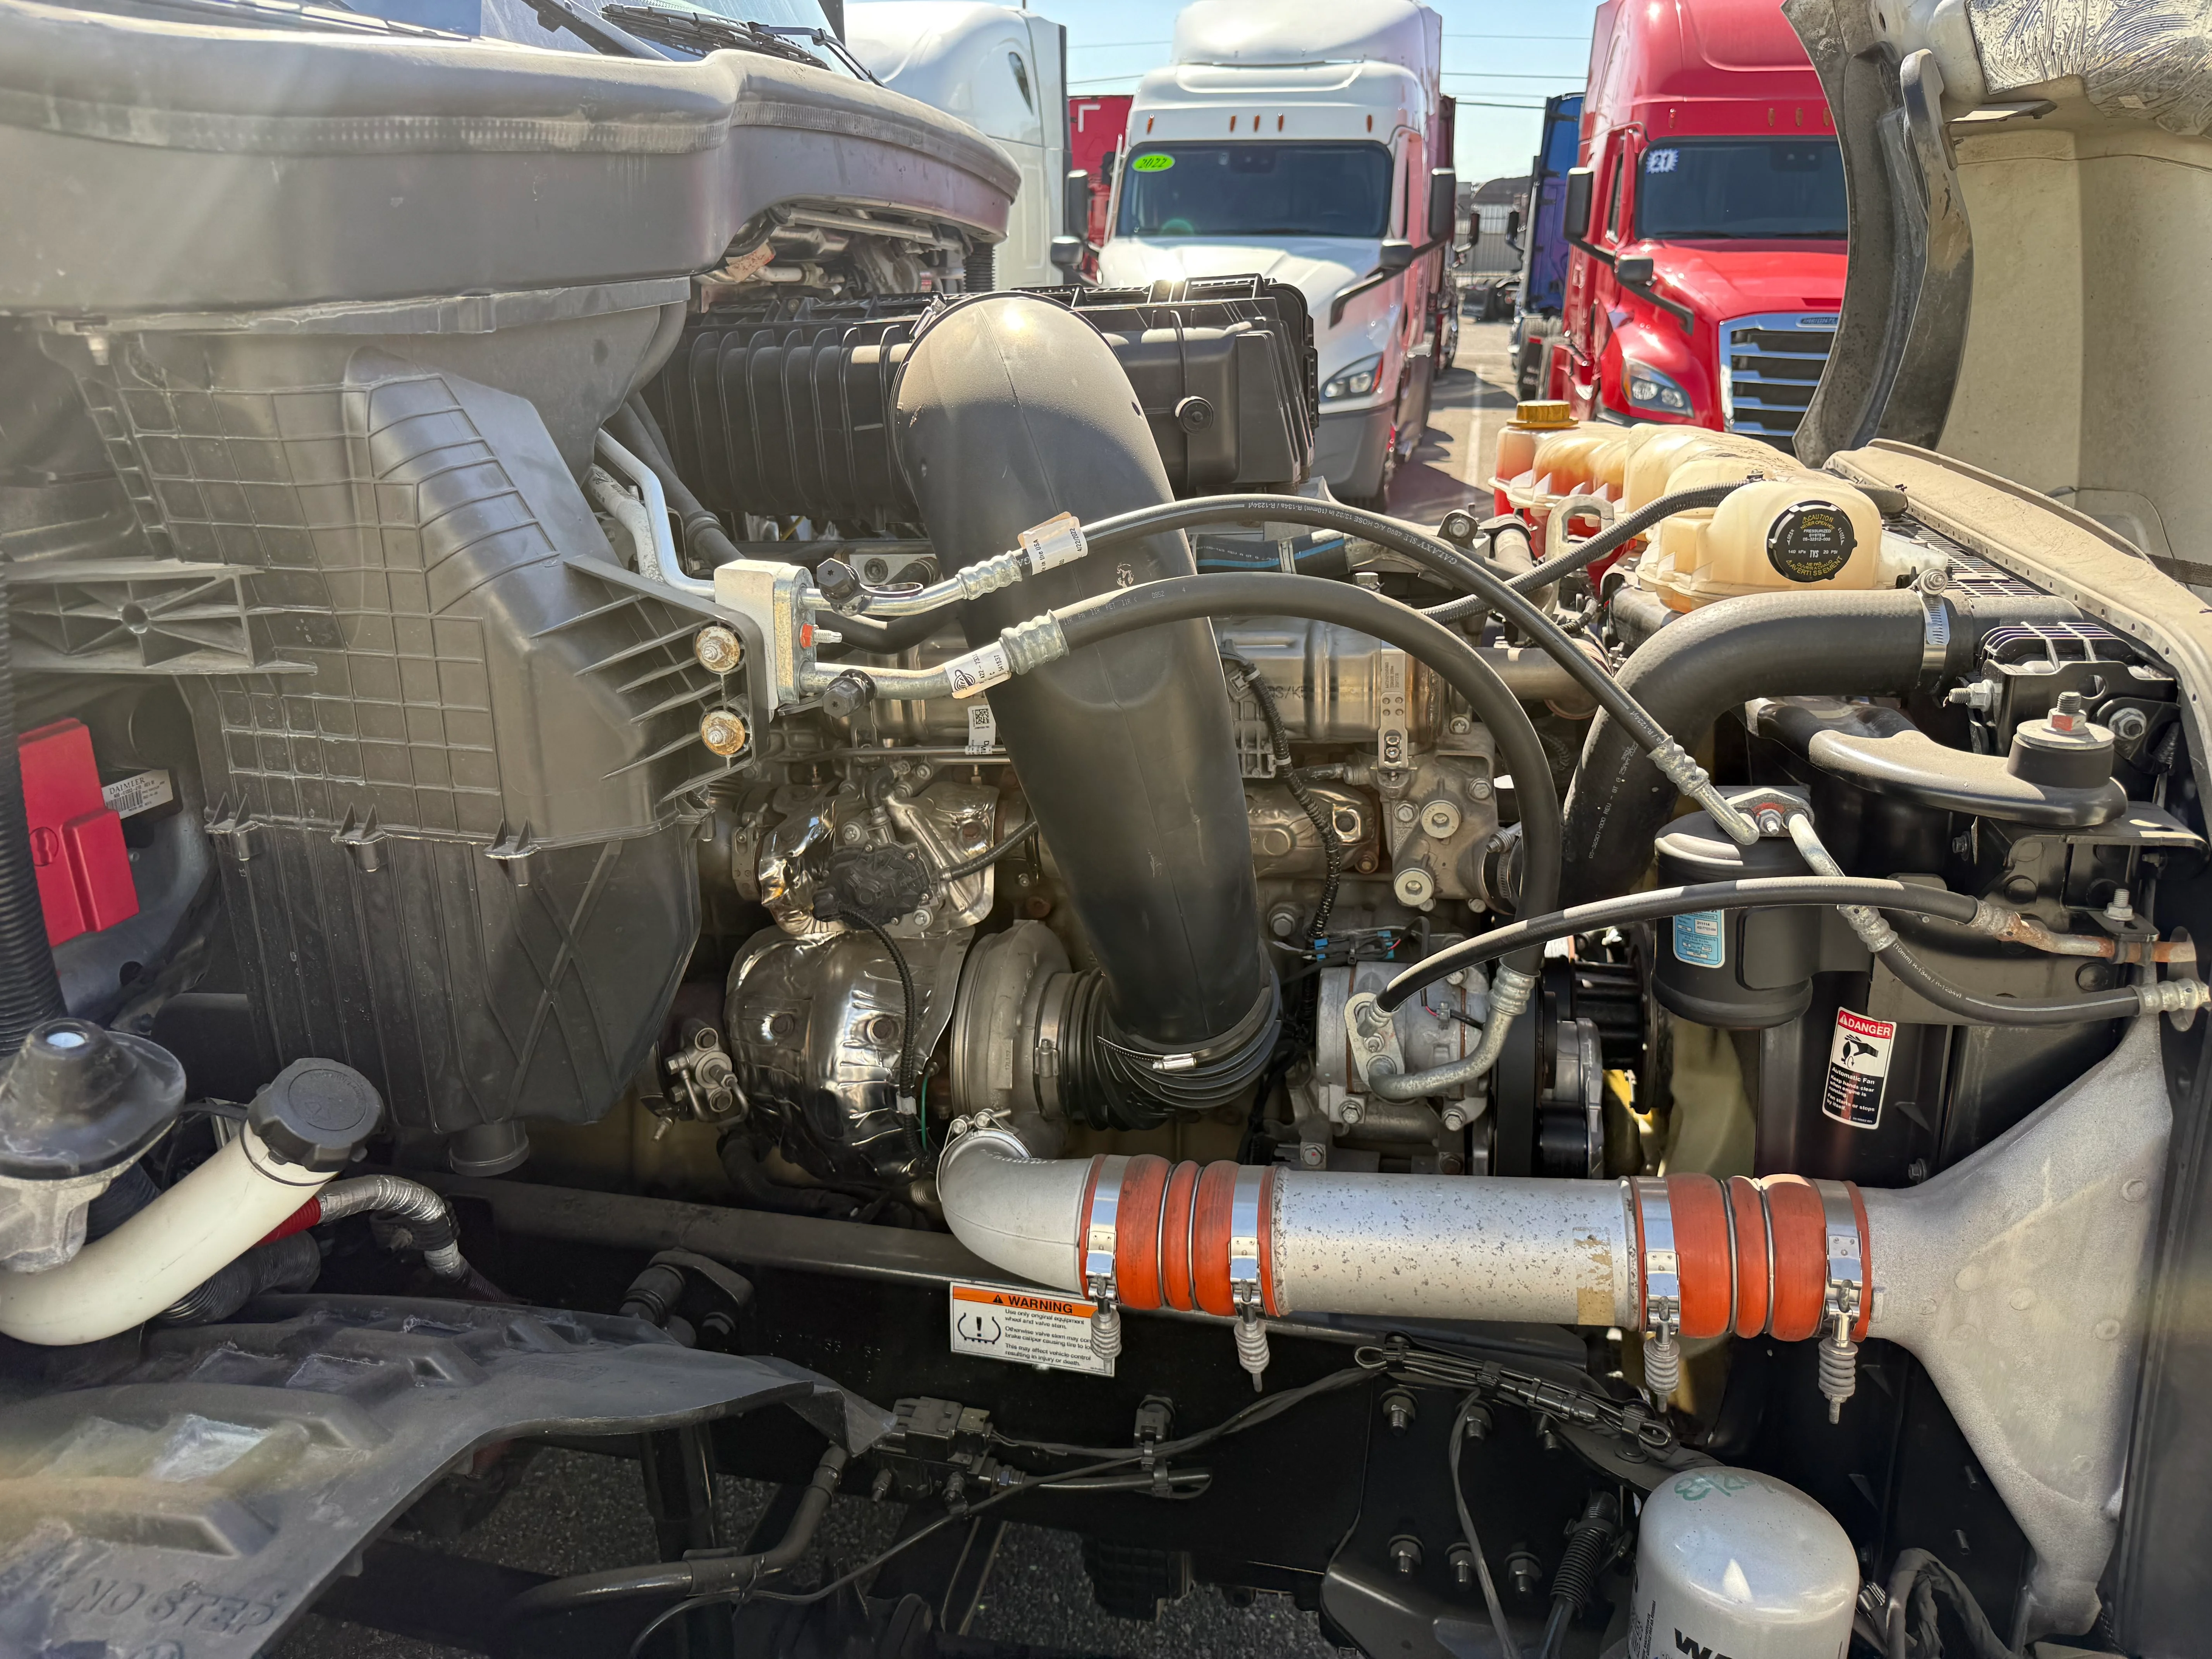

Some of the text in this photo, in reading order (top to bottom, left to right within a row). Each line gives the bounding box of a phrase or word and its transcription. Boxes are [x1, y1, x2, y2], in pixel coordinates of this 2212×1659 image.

[1139, 158, 1167, 168] 2022
[1354, 516, 1373, 527] HOSE
[1808, 514, 1834, 522] CAUTION
[1800, 521, 1815, 530] NEVER
[1417, 541, 1457, 564] GALAXY
[1810, 550, 1819, 558] TVS
[110, 777, 145, 794] DAIMLER
[1893, 943, 1912, 964] (10mm)
[1848, 1018, 1891, 1036] DANGER
[1832, 1067, 1861, 1082] Automatic
[1830, 1081, 1841, 1089] when
[1842, 1087, 1860, 1096] engine
[1831, 1075, 1842, 1084] Keep
[1843, 1080, 1858, 1089] hands
[1008, 1295, 1073, 1314] WARNING
[1054, 1316, 1084, 1324] equipment
[1005, 1326, 1034, 1334] Otherwise
[1005, 1351, 1030, 1359] resulting
[65, 1579, 146, 1616] NO
